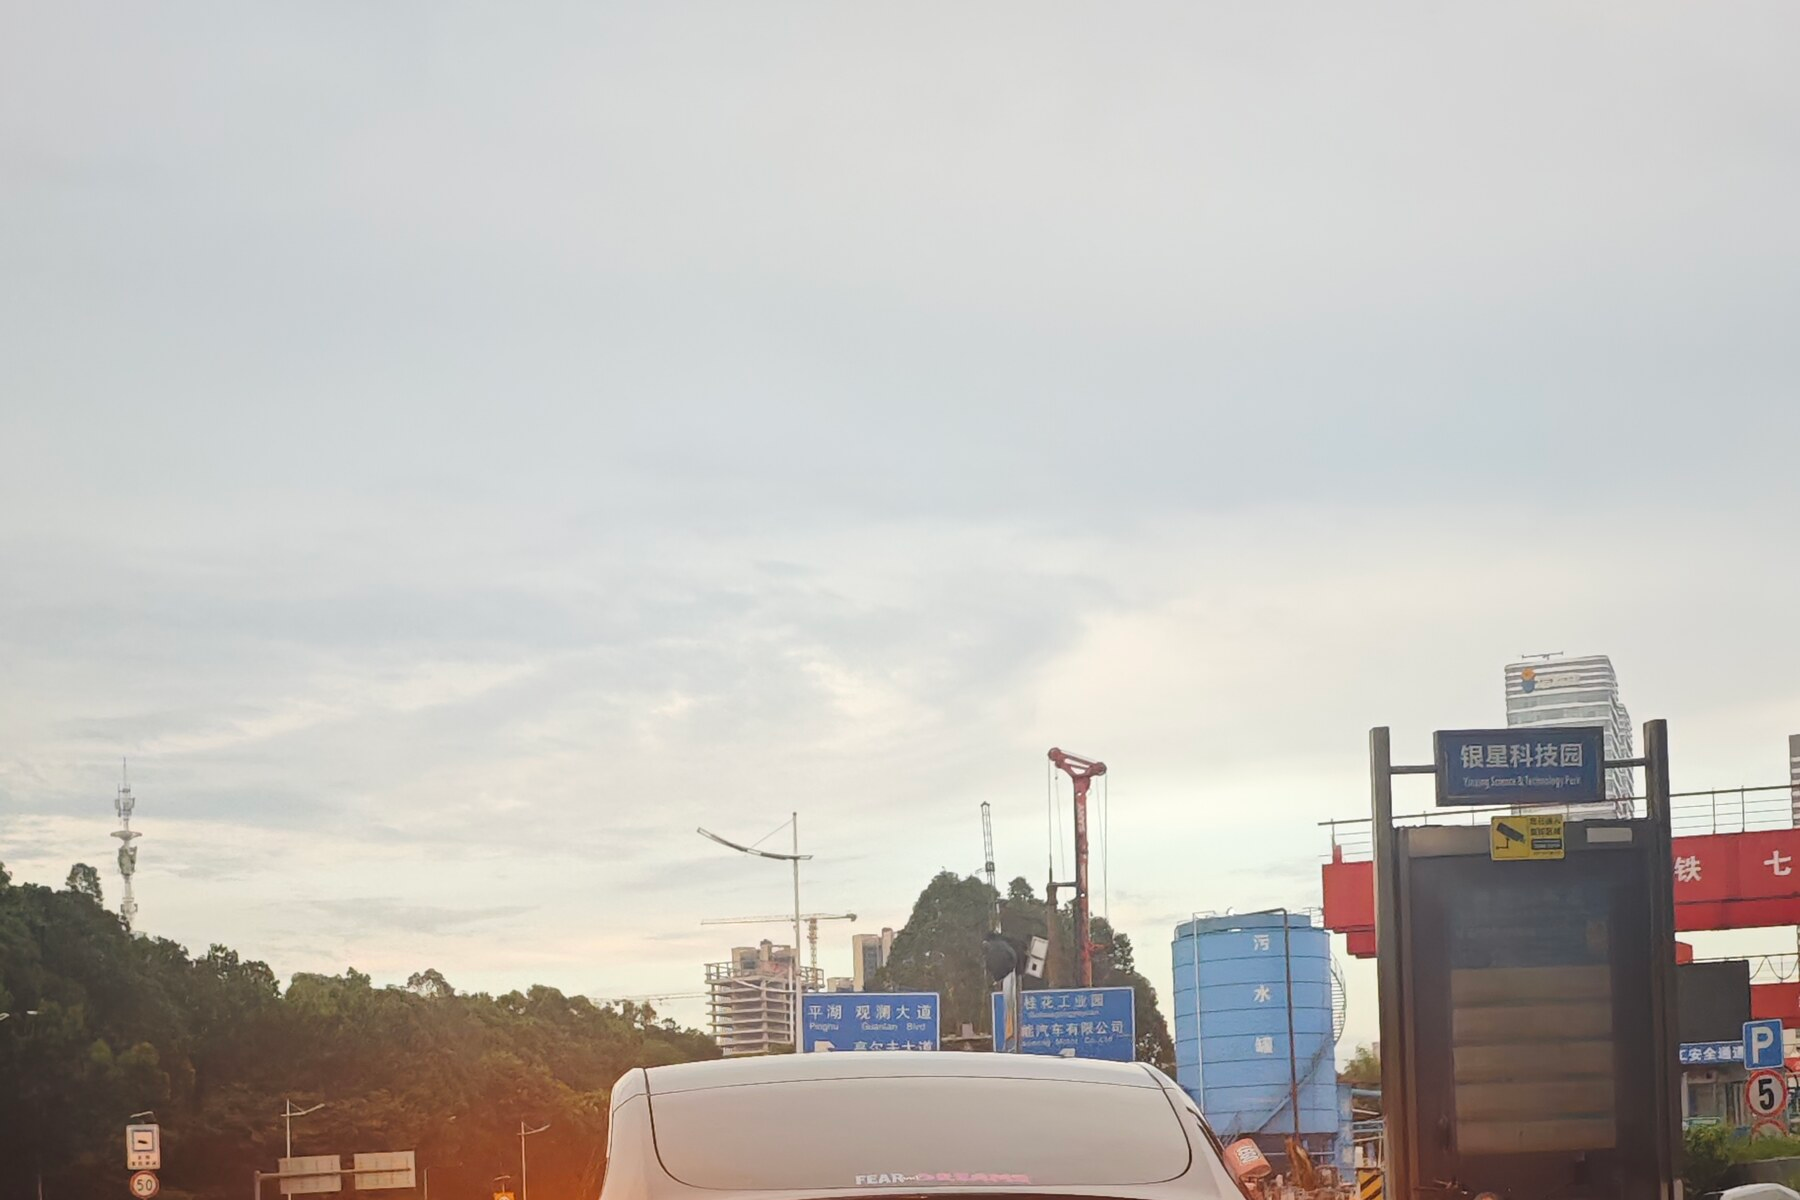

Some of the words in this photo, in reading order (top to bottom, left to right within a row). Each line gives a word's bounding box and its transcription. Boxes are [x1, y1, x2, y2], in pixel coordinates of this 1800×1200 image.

[1460, 743, 1584, 769] 银星科技园
[808, 1004, 842, 1020] 平湖
[855, 1004, 932, 1020] 观澜大道
[1752, 1026, 1774, 1064] P
[1758, 1078, 1775, 1110] 5
[137, 1179, 153, 1191] 50
[855, 1173, 904, 1185] FEAR
